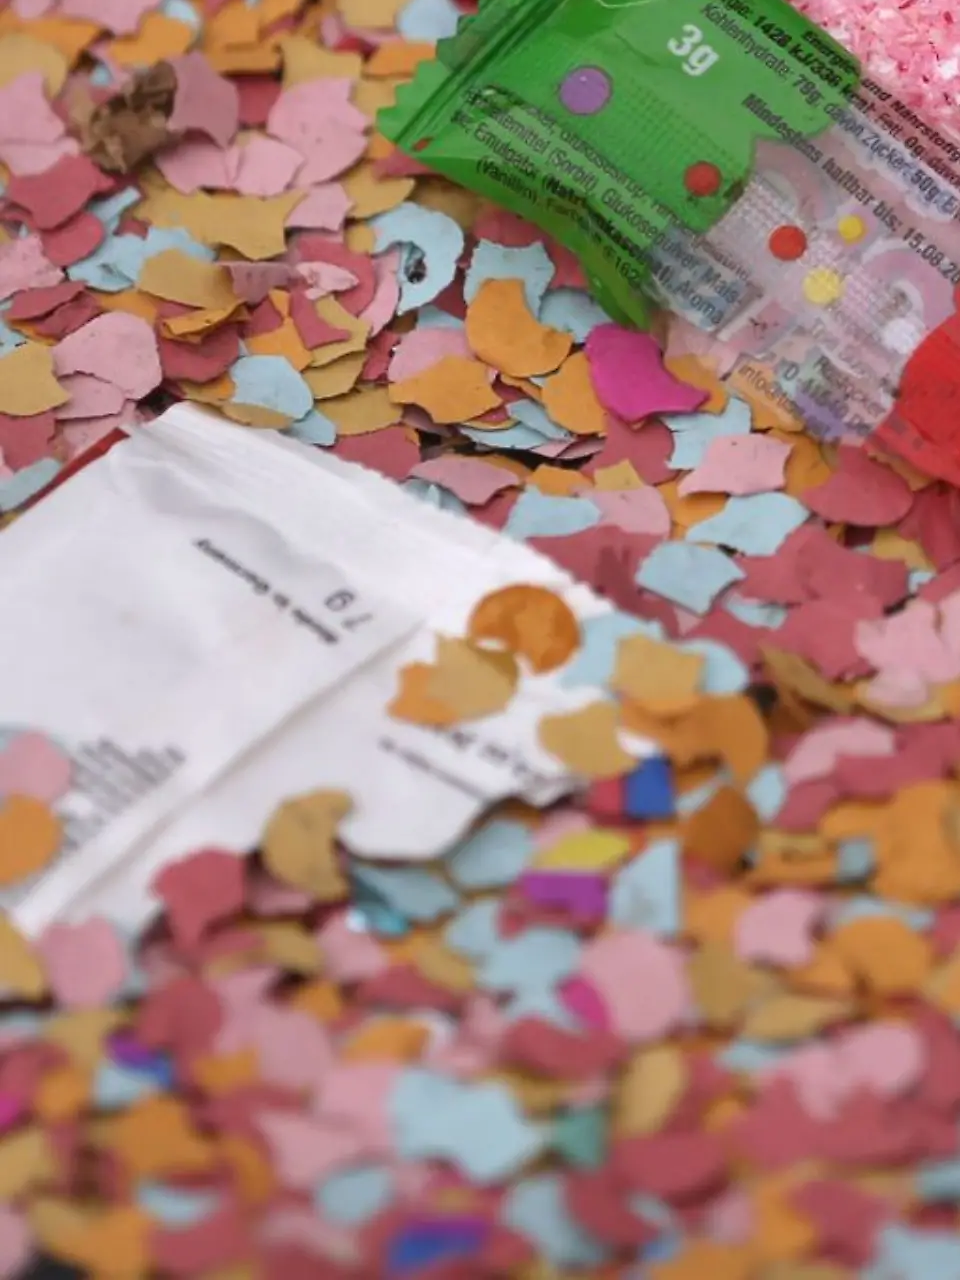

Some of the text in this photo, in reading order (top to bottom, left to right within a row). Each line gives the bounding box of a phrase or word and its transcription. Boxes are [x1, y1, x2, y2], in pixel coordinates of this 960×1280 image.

[662, 16, 725, 85] 3g
[698, 0, 795, 83] Kohlenhydrate:
[821, 98, 865, 140] davon
[859, 75, 892, 105] und
[471, 120, 543, 182] Emulgator
[673, 276, 728, 327] Aroma
[739, 89, 826, 165] Mindestens
[820, 154, 878, 210] haltbar
[870, 196, 906, 234] bis:
